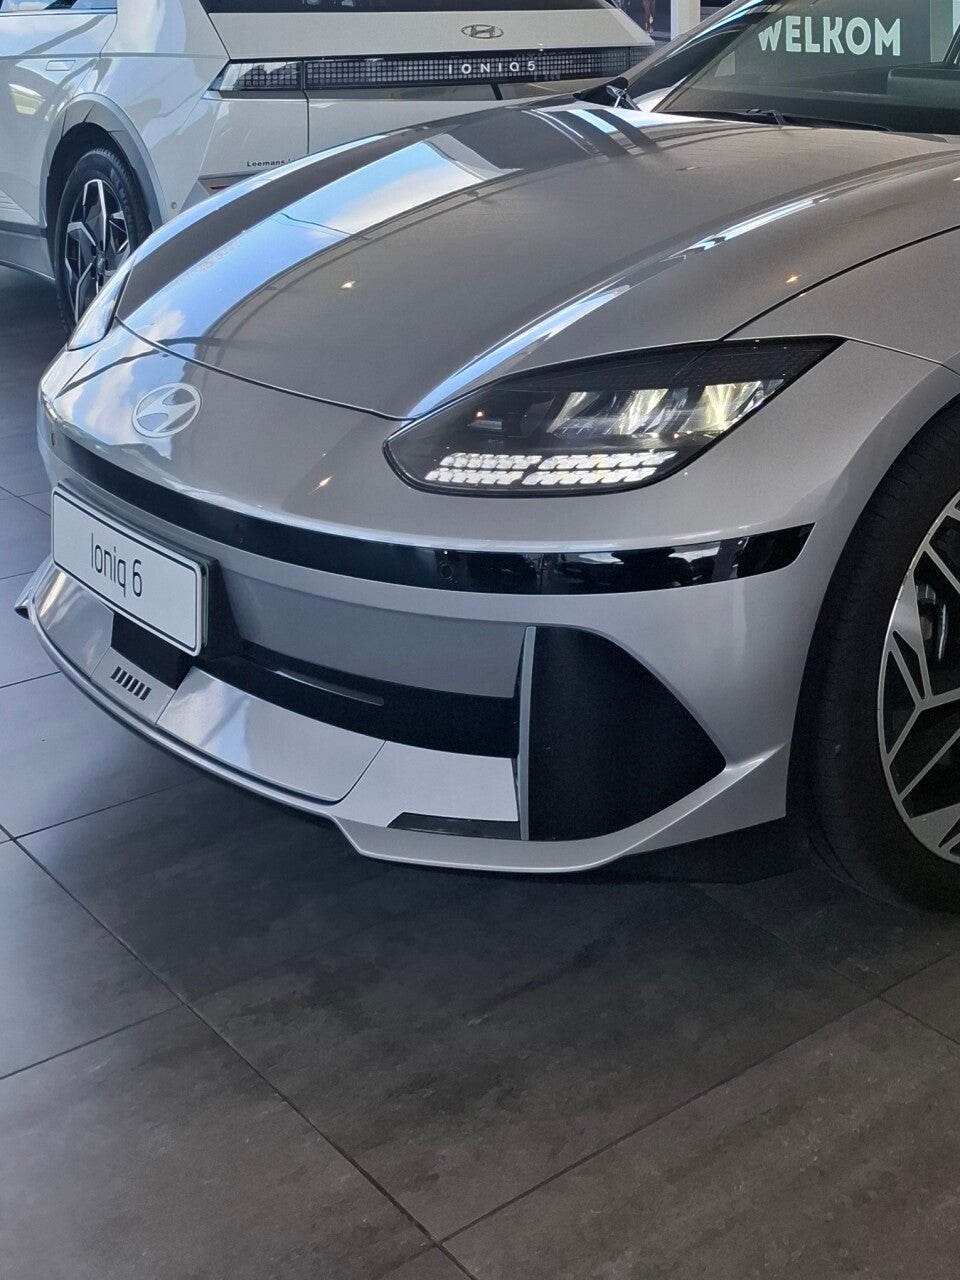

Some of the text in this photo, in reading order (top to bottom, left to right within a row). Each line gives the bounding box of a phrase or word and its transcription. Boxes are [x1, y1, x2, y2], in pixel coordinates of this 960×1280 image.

[758, 15, 901, 57] WELKOM
[449, 60, 536, 75] IONIQ 5
[91, 532, 143, 598] Ioniq 6
